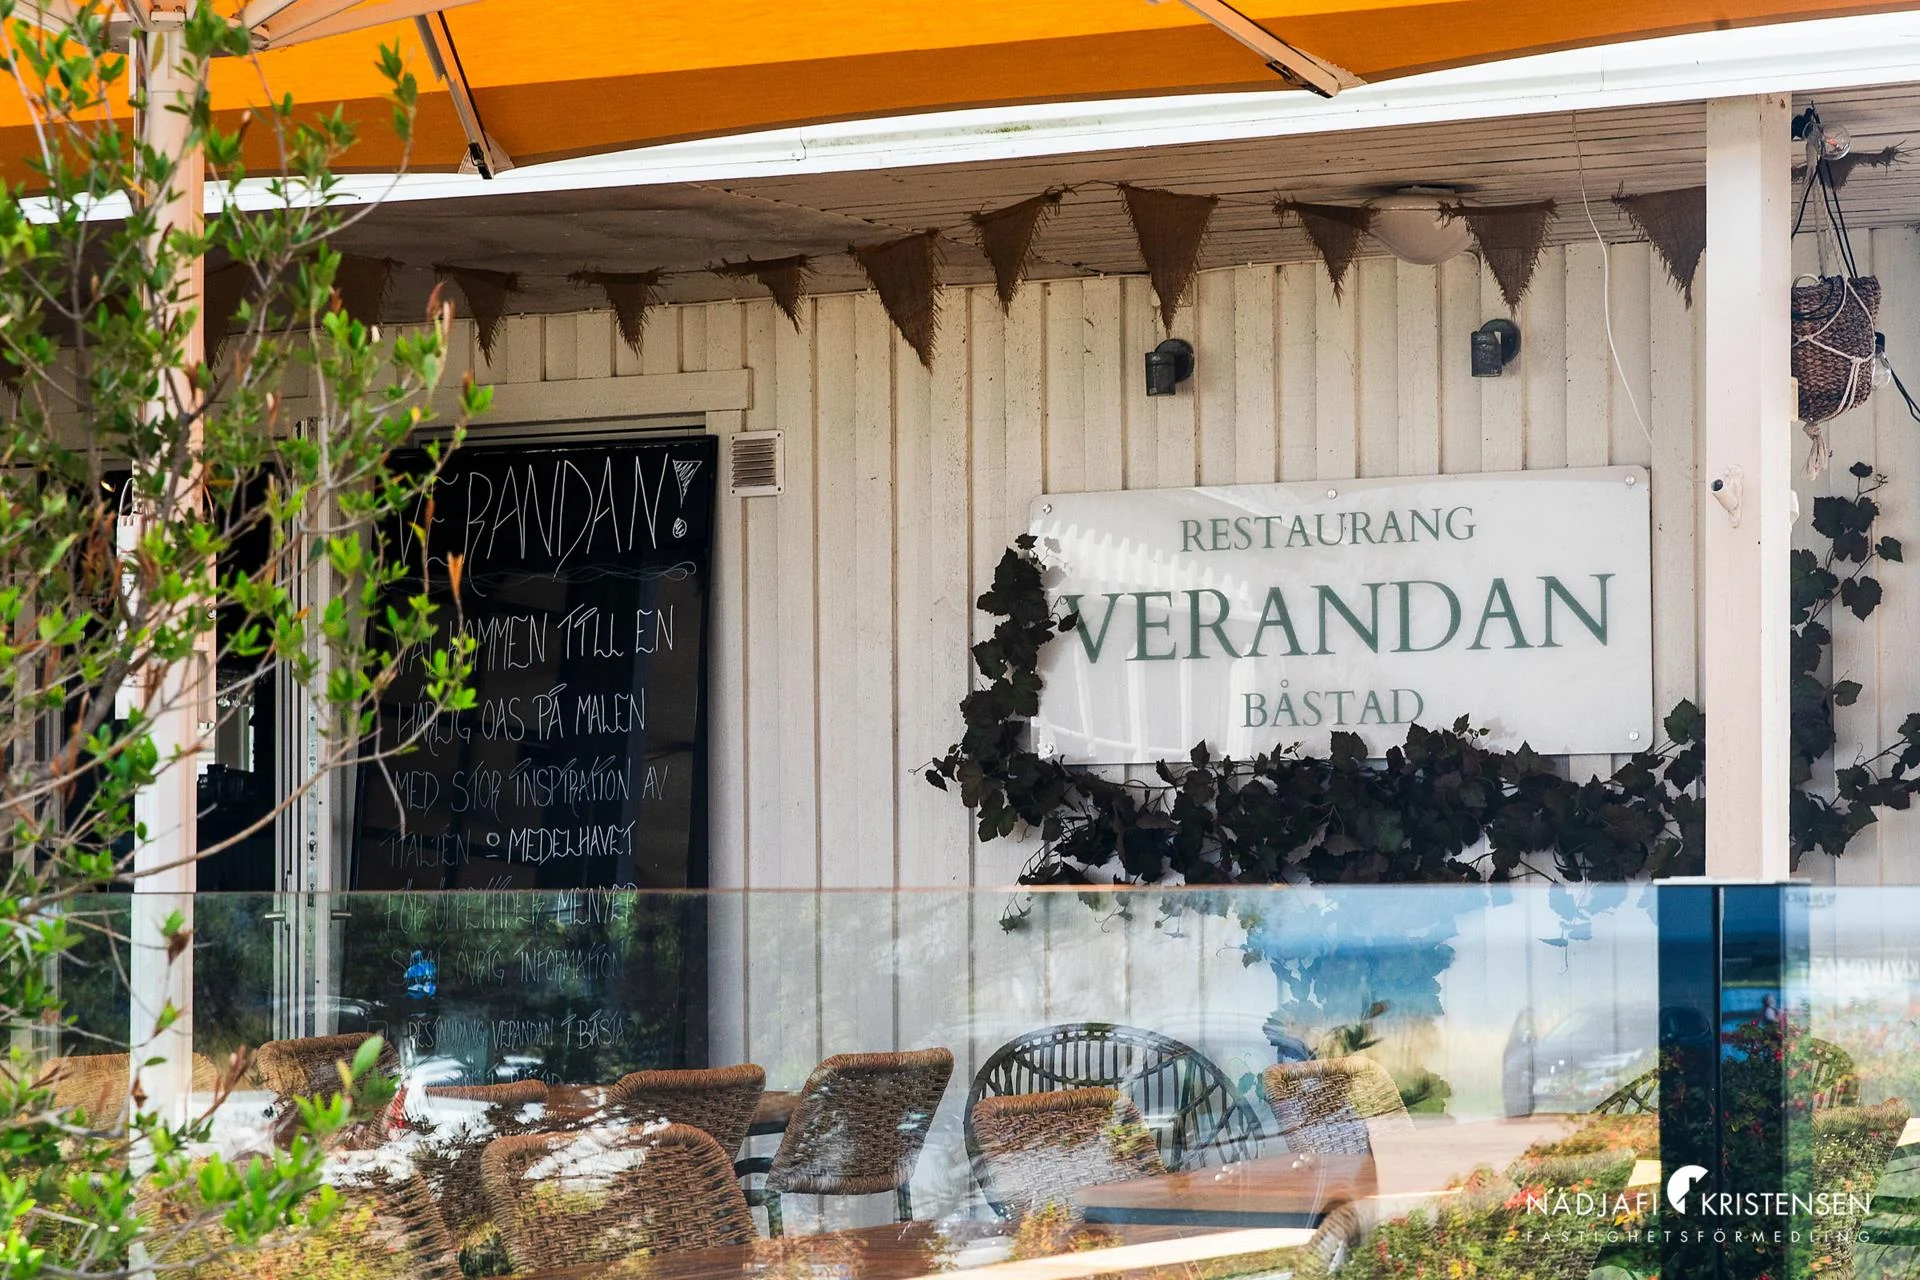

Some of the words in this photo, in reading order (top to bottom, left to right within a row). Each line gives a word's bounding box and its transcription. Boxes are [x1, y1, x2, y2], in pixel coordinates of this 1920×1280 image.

[1181, 506, 1477, 552] RESTAURANG
[557, 603, 624, 659] TILL
[635, 604, 674, 654] EN
[1058, 573, 1616, 664] VERANDAN
[481, 697, 526, 742] OAS
[532, 683, 568, 741] PÅ
[575, 687, 645, 735] MALEN
[1241, 679, 1424, 728] BÅSTAD
[393, 770, 440, 809] MED
[452, 761, 502, 822] STOR
[508, 755, 632, 818] INSPIRATION
[642, 765, 669, 801] AV
[508, 820, 636, 866] MEDELHAVET
